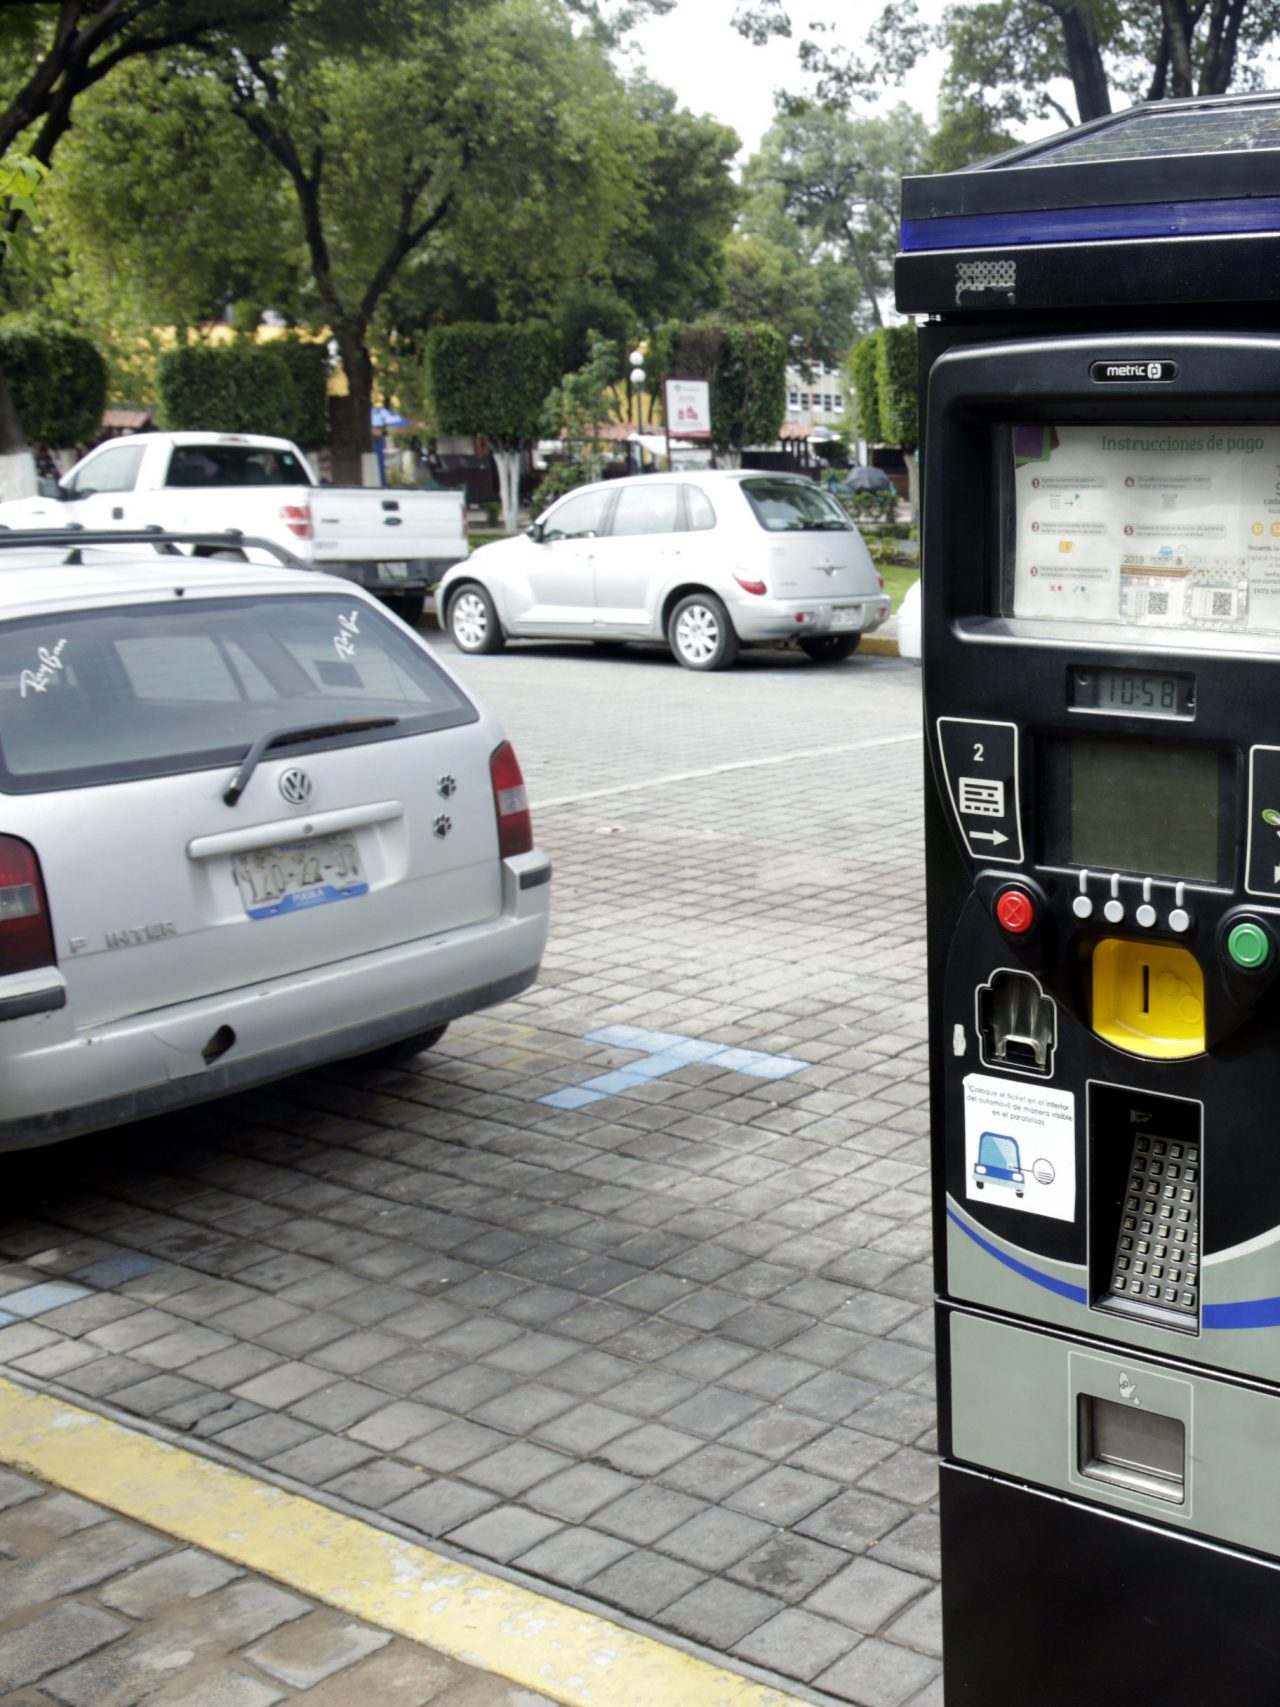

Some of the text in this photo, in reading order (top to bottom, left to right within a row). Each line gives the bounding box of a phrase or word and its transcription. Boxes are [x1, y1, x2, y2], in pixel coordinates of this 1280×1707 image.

[1106, 365, 1145, 377] metric
[1101, 434, 1264, 454] Instrucciones de pago
[1123, 555, 1145, 565] 2018
[1108, 678, 1177, 709] 10:58
[973, 743, 985, 762] 2
[1007, 1093, 1026, 1102] ticket
[1046, 1100, 1069, 1111] interior
[1023, 1106, 1050, 1117] manera
[1051, 1110, 1073, 1121] visible
